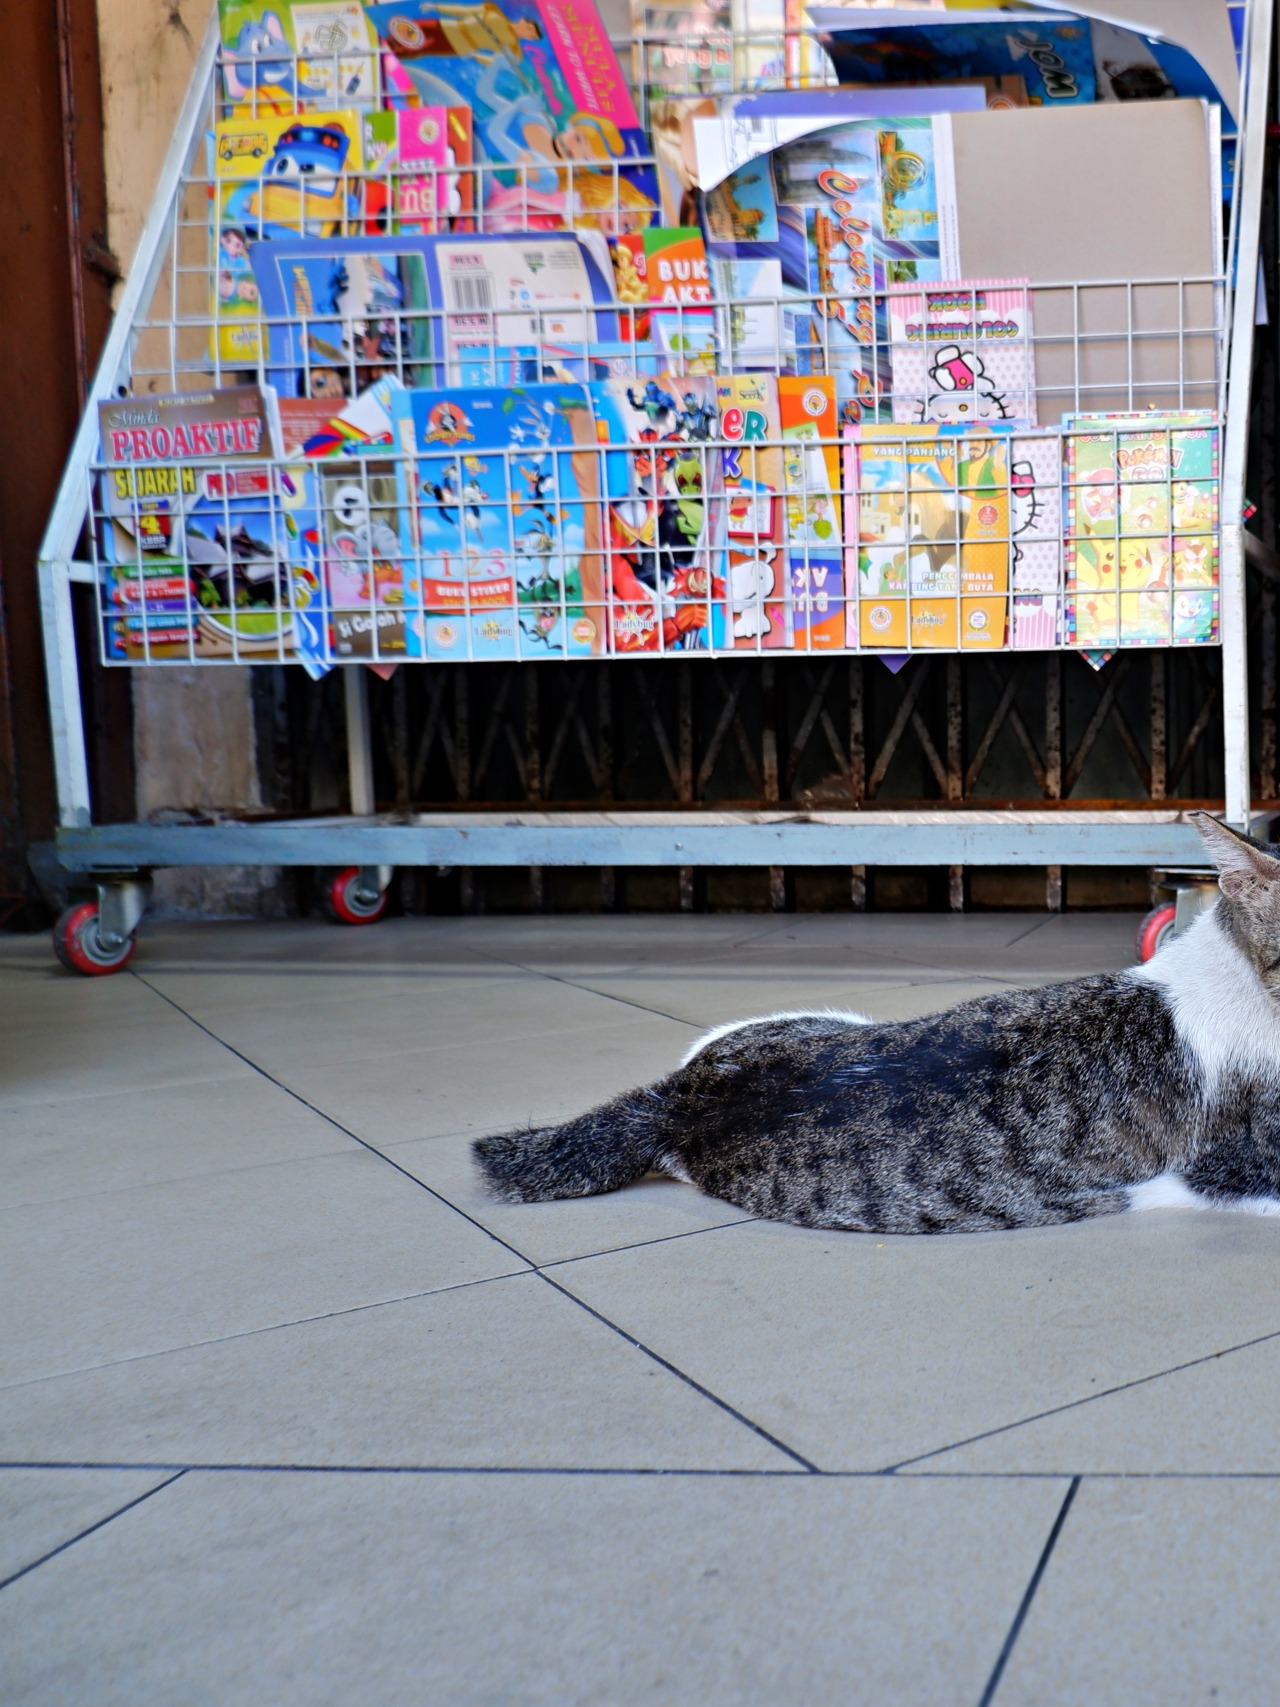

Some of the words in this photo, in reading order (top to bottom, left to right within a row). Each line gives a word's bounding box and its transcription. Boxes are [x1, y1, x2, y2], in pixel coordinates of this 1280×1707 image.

[1020, 38, 1078, 98] JOM
[928, 292, 987, 312] BOOK
[905, 320, 1020, 342] COLOURING
[110, 416, 262, 463] PROAKTIF
[873, 447, 902, 457] YANG
[139, 514, 161, 536] 4
[471, 582, 511, 597] STIKER
[967, 582, 994, 592] BUTA
[351, 611, 397, 634] Gaah
